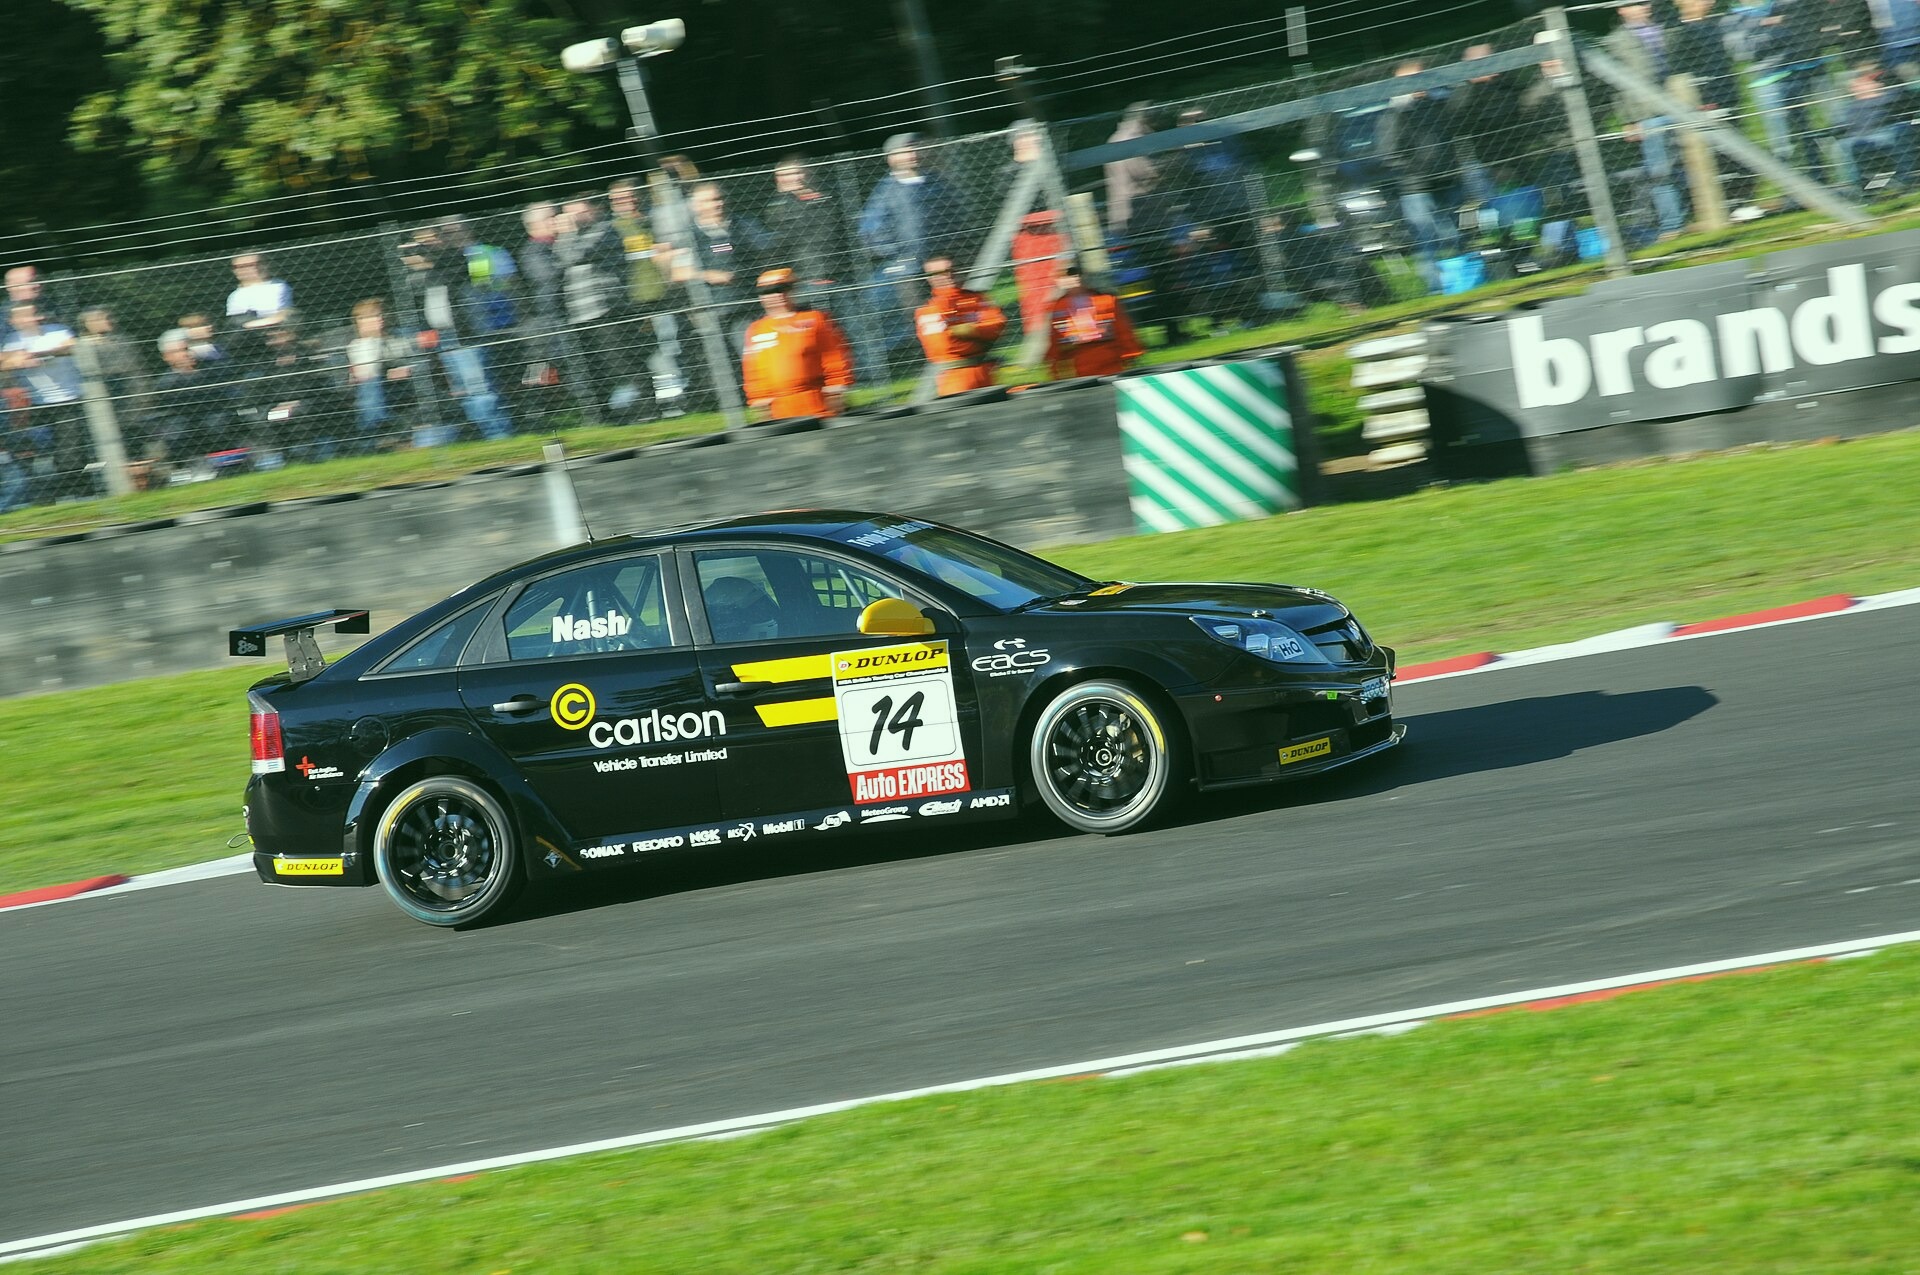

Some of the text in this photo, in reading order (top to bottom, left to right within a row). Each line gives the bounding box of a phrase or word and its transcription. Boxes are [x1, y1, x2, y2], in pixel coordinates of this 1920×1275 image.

[1507, 263, 1920, 409] brands
[552, 610, 626, 643] Nash
[1279, 640, 1302, 657] HiQ
[855, 648, 944, 669] DUNLOP
[971, 649, 1051, 671] eacs
[906, 667, 947, 677] Championship
[588, 709, 727, 749] carlson
[869, 691, 925, 756] 14
[1290, 742, 1329, 759] DUNLOP
[593, 748, 728, 773] Vehicle Transfer Limited
[856, 763, 965, 801] Auto EXPRESS
[861, 805, 909, 818] MeteoGroup
[689, 829, 721, 843] NGK
[763, 820, 794, 835] Mobil
[580, 843, 626, 859] SONAX
[633, 836, 684, 853] RECARO
[286, 863, 339, 871] DUNLOP
